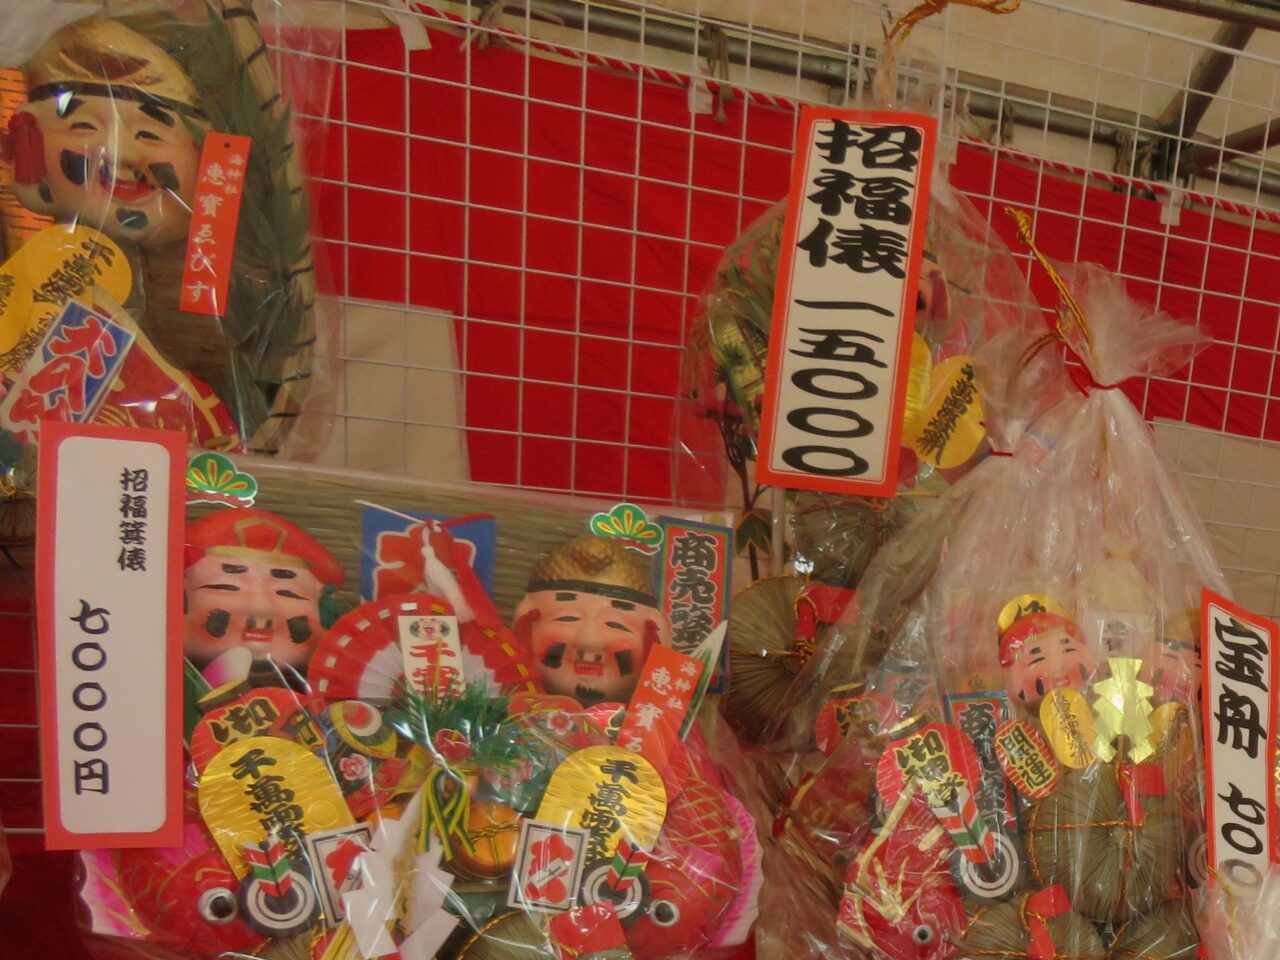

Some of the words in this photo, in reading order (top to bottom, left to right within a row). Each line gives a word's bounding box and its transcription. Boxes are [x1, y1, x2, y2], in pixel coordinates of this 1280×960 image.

[798, 118, 922, 279] 招福俵
[1213, 616, 1269, 759] 宝舟
